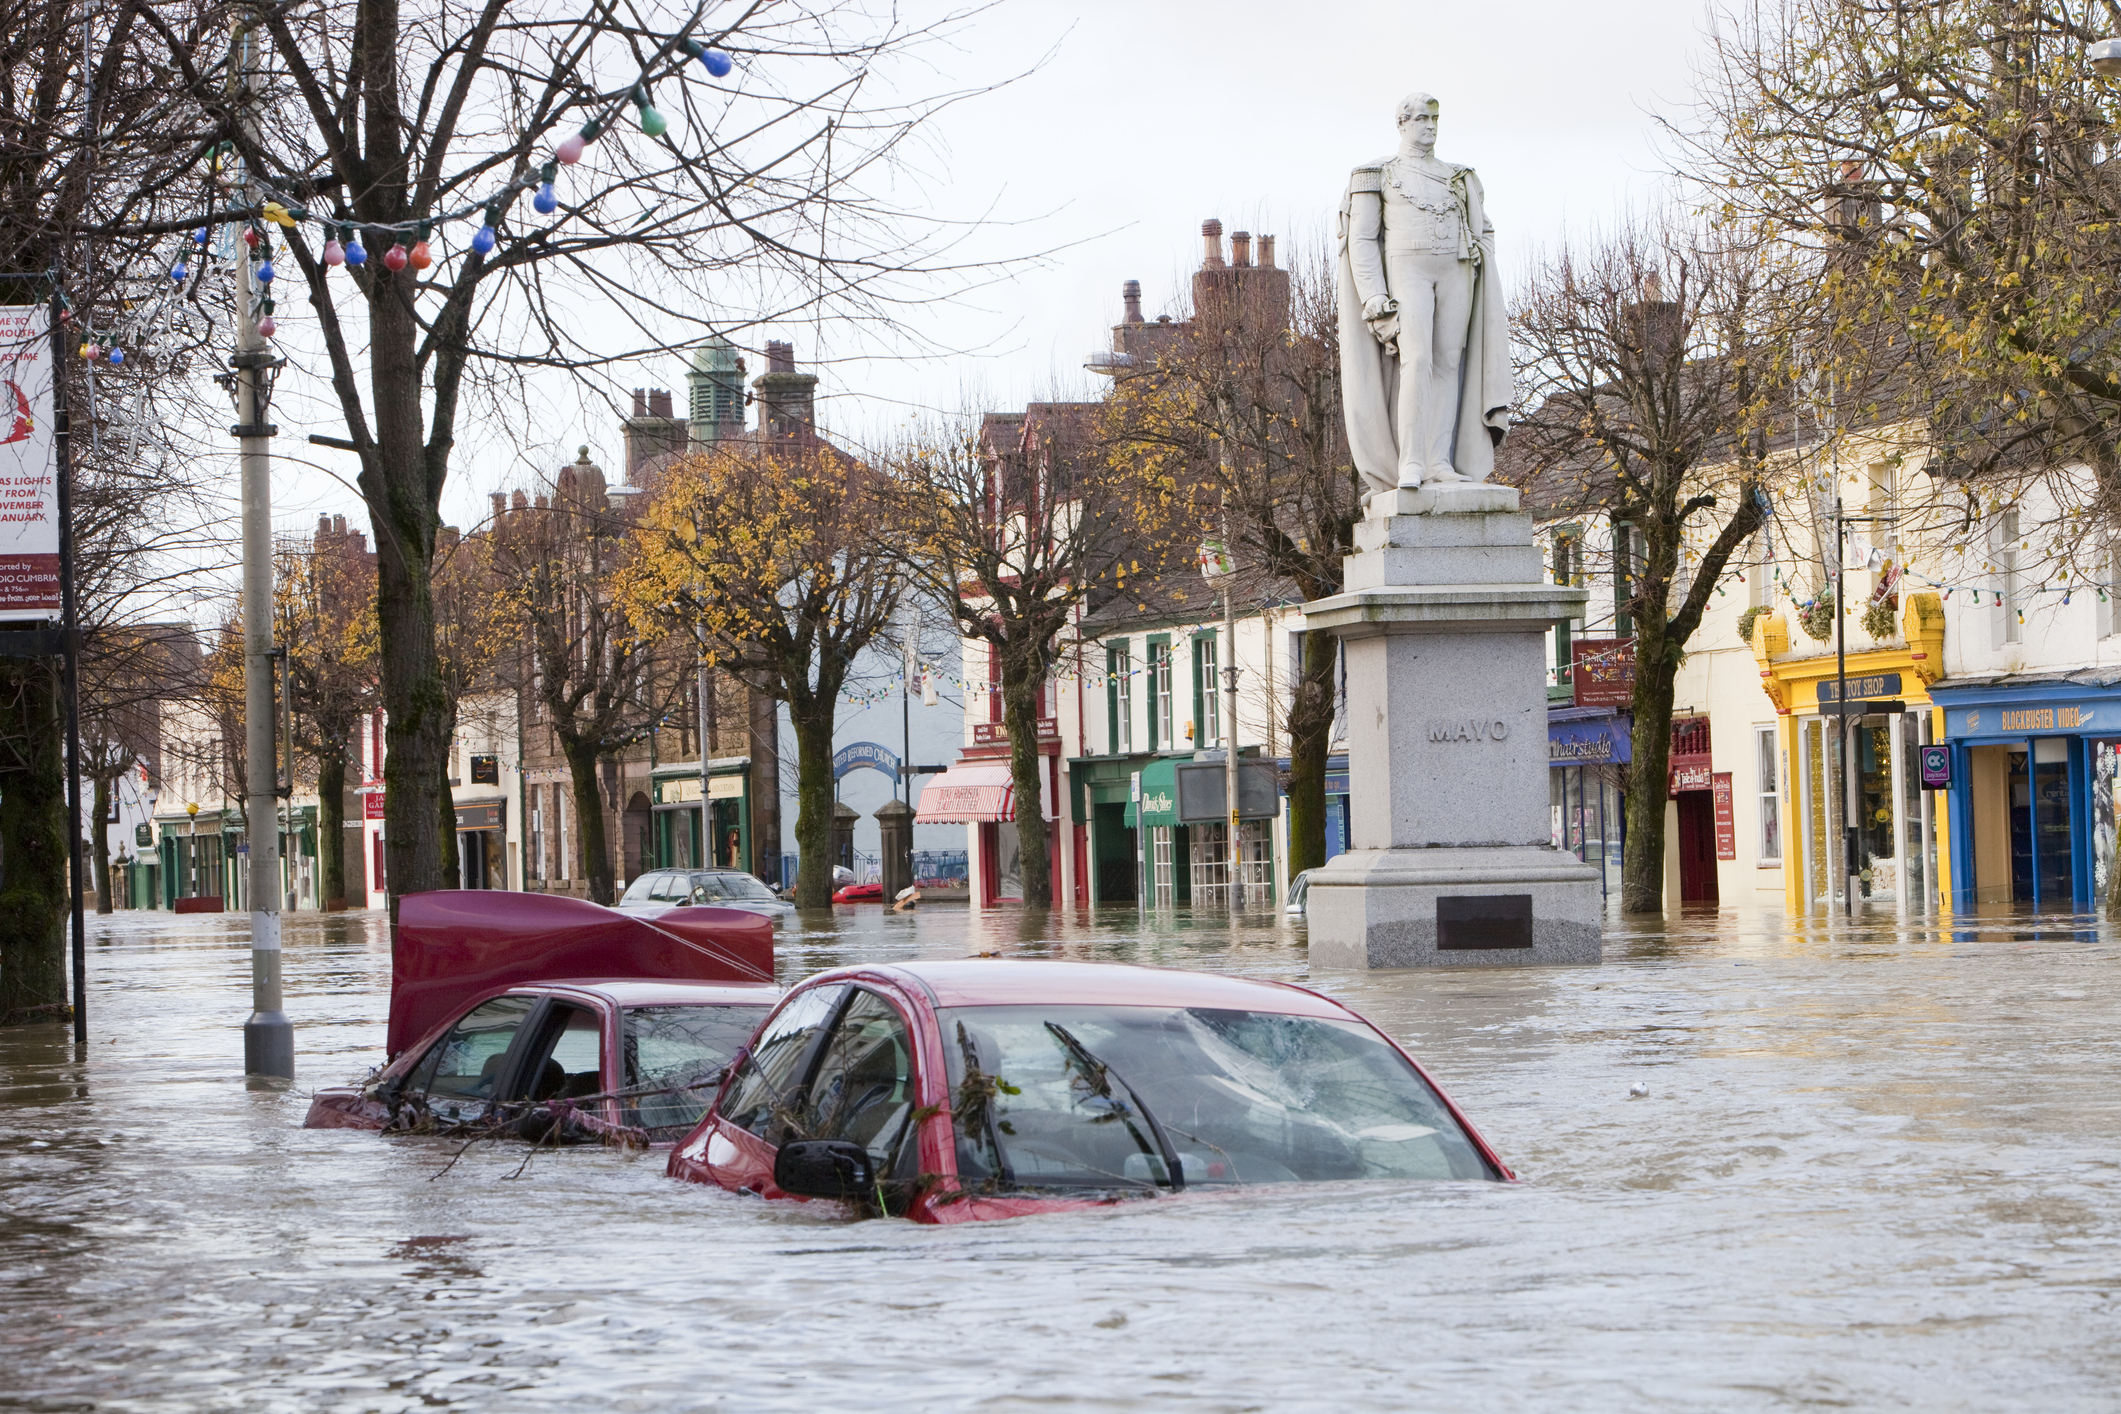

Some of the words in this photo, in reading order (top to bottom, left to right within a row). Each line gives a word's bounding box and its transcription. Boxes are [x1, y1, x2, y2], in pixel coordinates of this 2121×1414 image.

[15, 317, 28, 326] TO
[15, 476, 52, 486] LIGHTS
[5, 489, 36, 498] FROM
[0, 501, 44, 510] VEMBER
[0, 513, 45, 522] ANUARY
[22, 563, 31, 572] by
[16, 574, 59, 582] CUMBRIA
[7, 594, 24, 602] from
[41, 593, 59, 601] local
[1829, 681, 1840, 699] TH
[1846, 680, 1862, 697] TOY
[1863, 677, 1885, 696] SHOP
[2002, 708, 2054, 731] BLOCKBUSTER
[2057, 707, 2079, 728] VIDEO
[1427, 719, 1509, 742] MAYO
[833, 751, 847, 768] NITED
[847, 746, 874, 762] REFORMED
[874, 748, 896, 770] CHURCH
